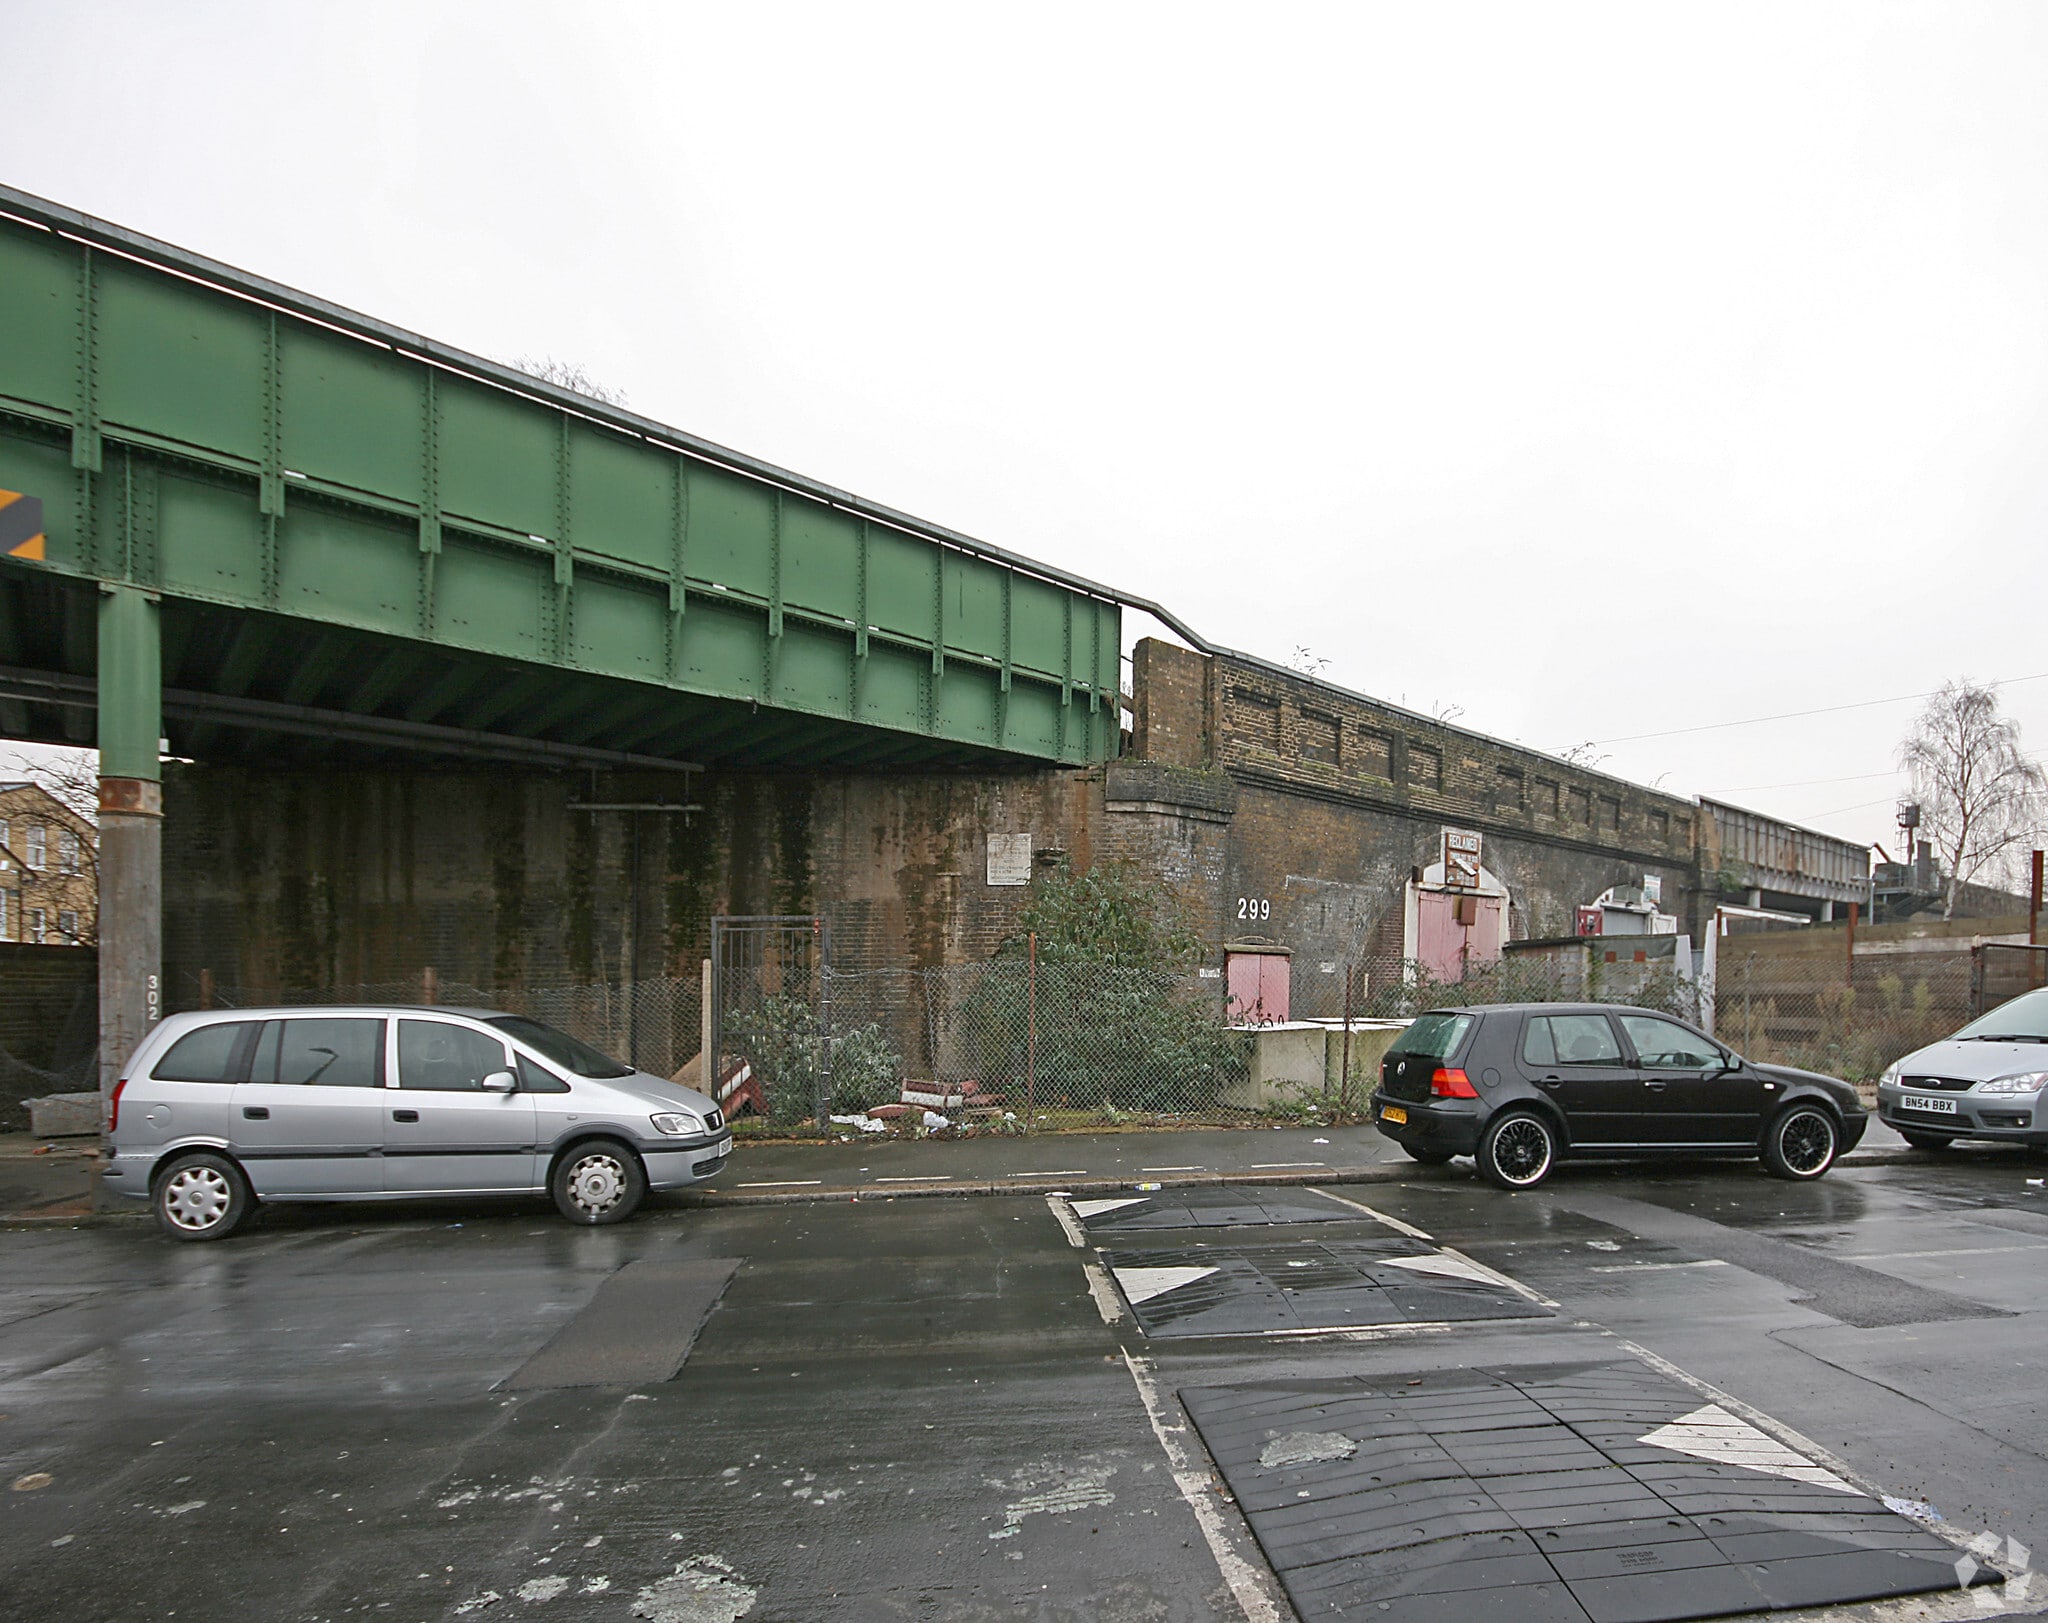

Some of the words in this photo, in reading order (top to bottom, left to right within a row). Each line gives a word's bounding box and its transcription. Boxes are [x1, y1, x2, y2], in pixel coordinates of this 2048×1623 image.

[1237, 897, 1270, 920] 299
[147, 975, 159, 1020] 302
[1905, 1097, 1929, 1109] BN54
[1932, 1100, 1953, 1112] BBX
